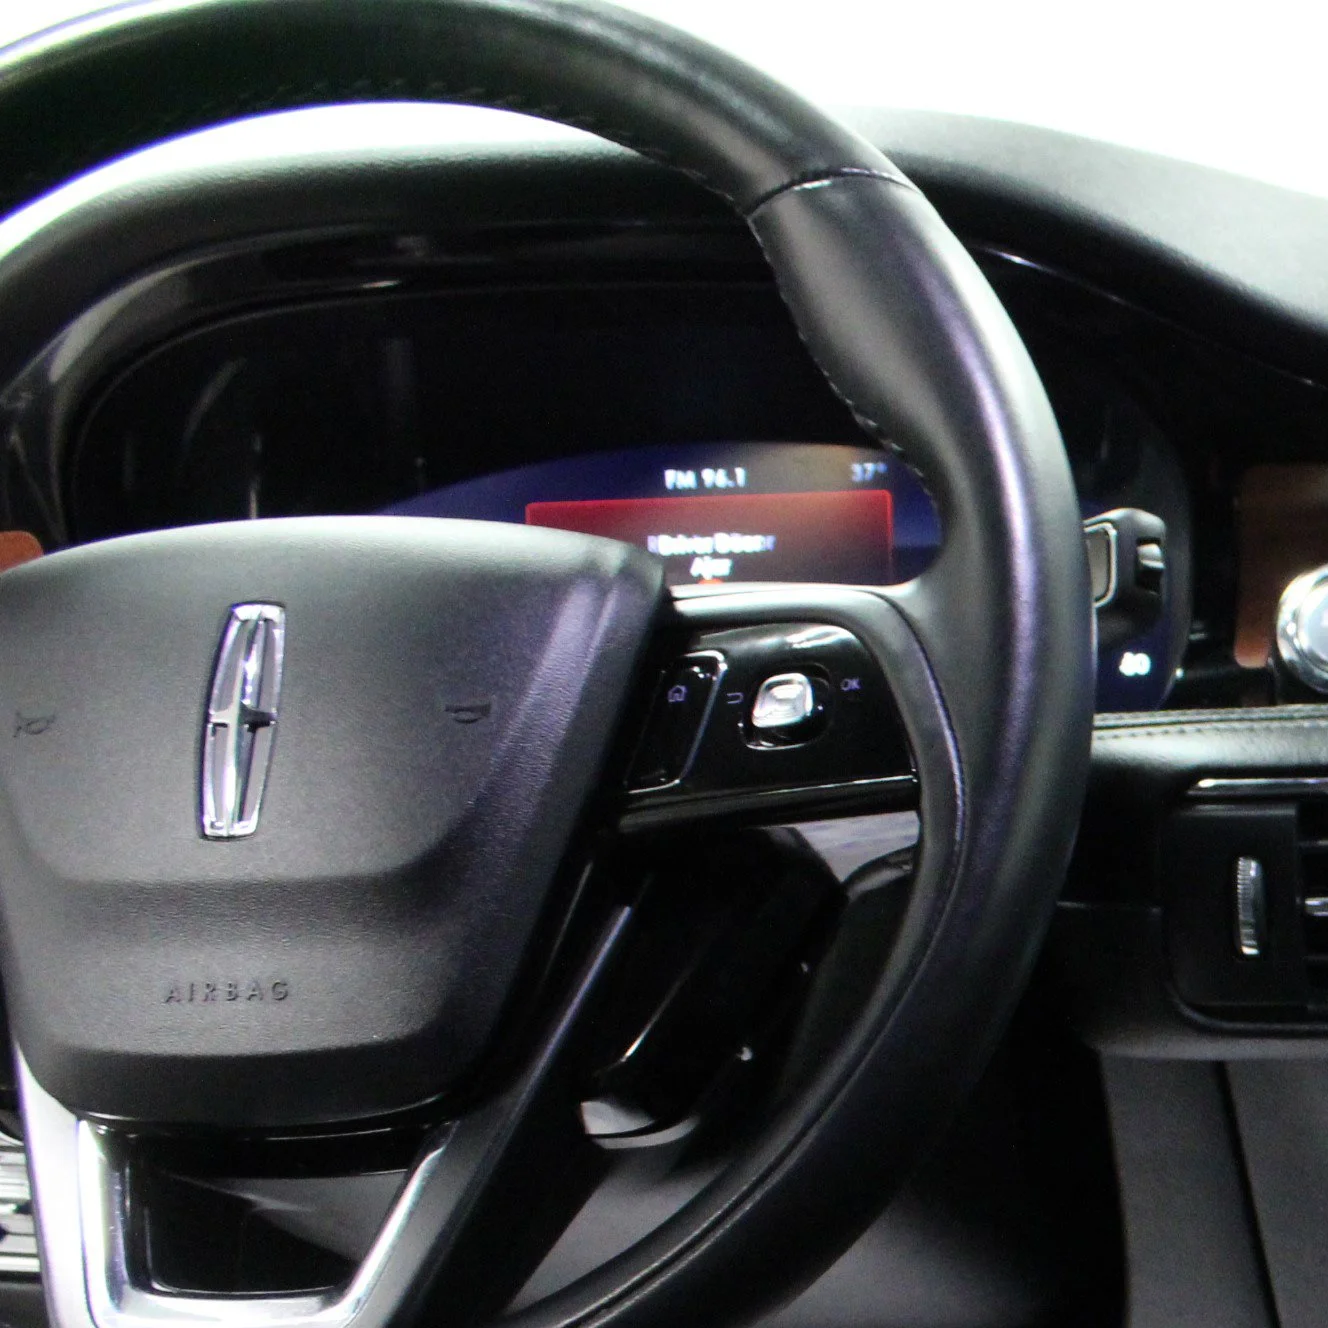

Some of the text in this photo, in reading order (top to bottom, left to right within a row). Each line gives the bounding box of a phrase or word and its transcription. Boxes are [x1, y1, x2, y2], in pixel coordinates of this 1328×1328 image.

[664, 467, 747, 490] FM 96.1
[163, 980, 289, 1003] AIRBAG
